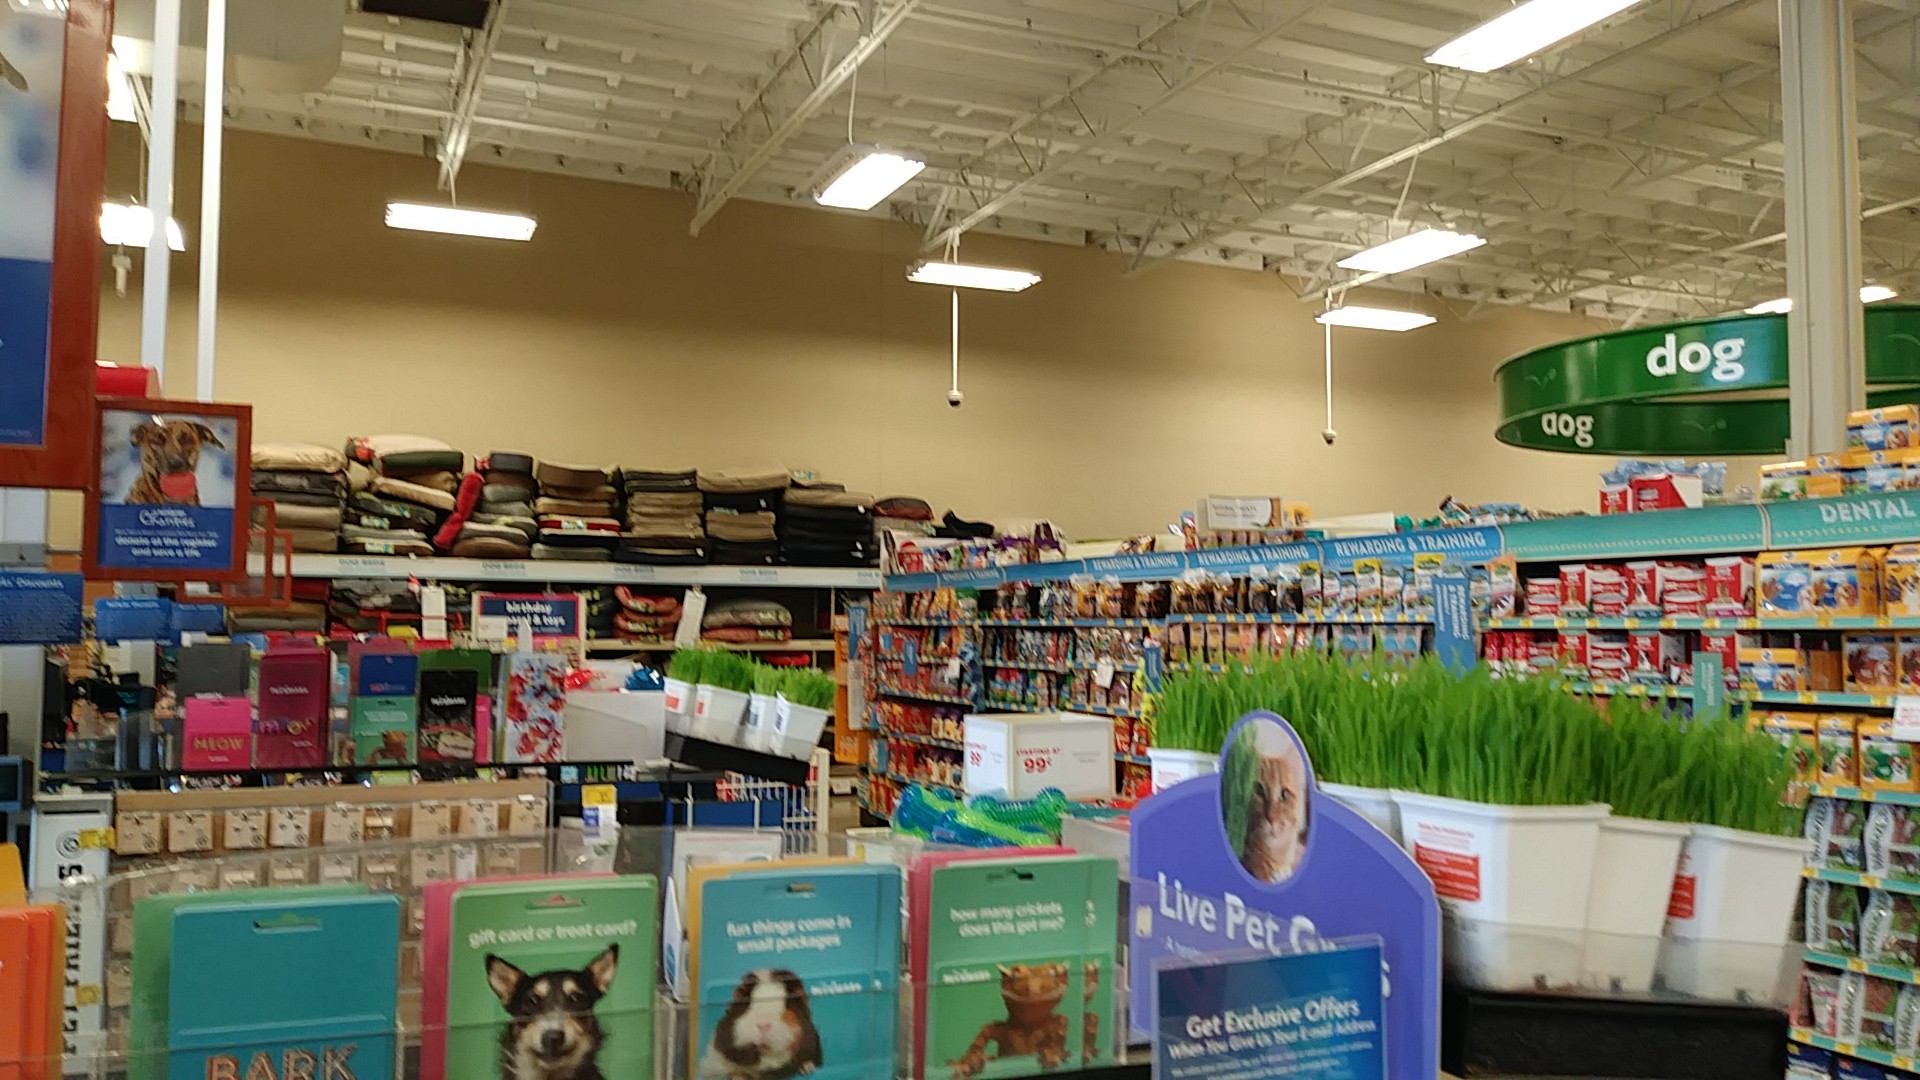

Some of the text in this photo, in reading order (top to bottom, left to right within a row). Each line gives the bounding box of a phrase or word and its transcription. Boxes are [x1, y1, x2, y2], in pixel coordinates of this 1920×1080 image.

[1646, 332, 1745, 382] dog
[1541, 411, 1594, 448] dog
[1818, 497, 1916, 524] DENTAL
[1260, 545, 1309, 561] TRAINING
[1335, 531, 1486, 556] REWARDING & TRAINING
[193, 736, 244, 751] MEOW
[950, 902, 1063, 922] how many crickets
[1158, 871, 1217, 933] Live
[1224, 891, 1282, 957] Pet
[468, 919, 637, 950] gift card or treat card?
[726, 914, 852, 937] fun things come in
[959, 923, 991, 938] does
[992, 921, 1016, 935] this
[737, 934, 841, 954] small packages
[1186, 995, 1361, 1039] Get Exclusive Offers
[206, 1043, 357, 1079] BARK
